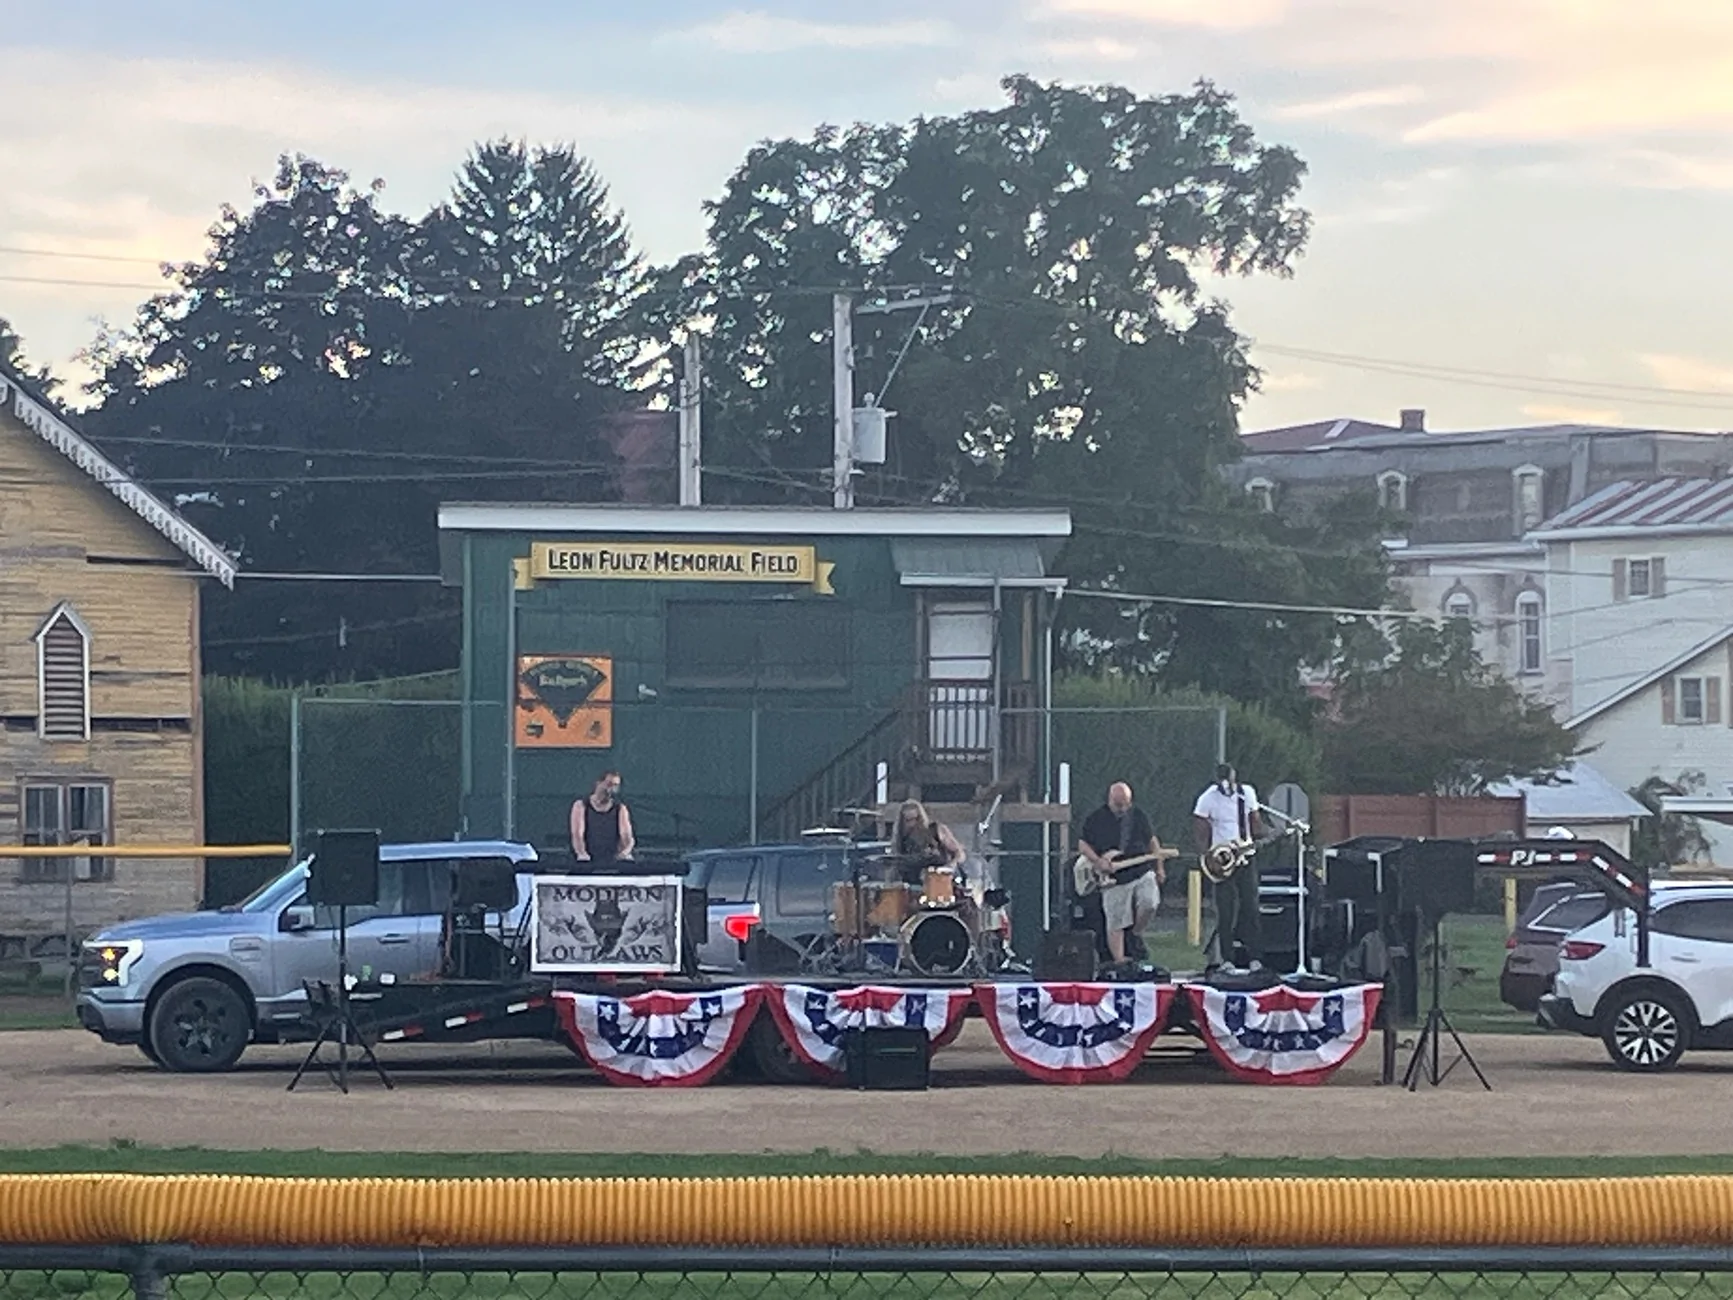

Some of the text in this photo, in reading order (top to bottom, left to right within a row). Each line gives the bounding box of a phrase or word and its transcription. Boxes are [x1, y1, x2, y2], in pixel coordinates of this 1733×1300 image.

[548, 549, 798, 574] LEON FULTZ MEMORIAL FIELD
[1509, 850, 1537, 866] PJ
[553, 886, 663, 902] MODERN
